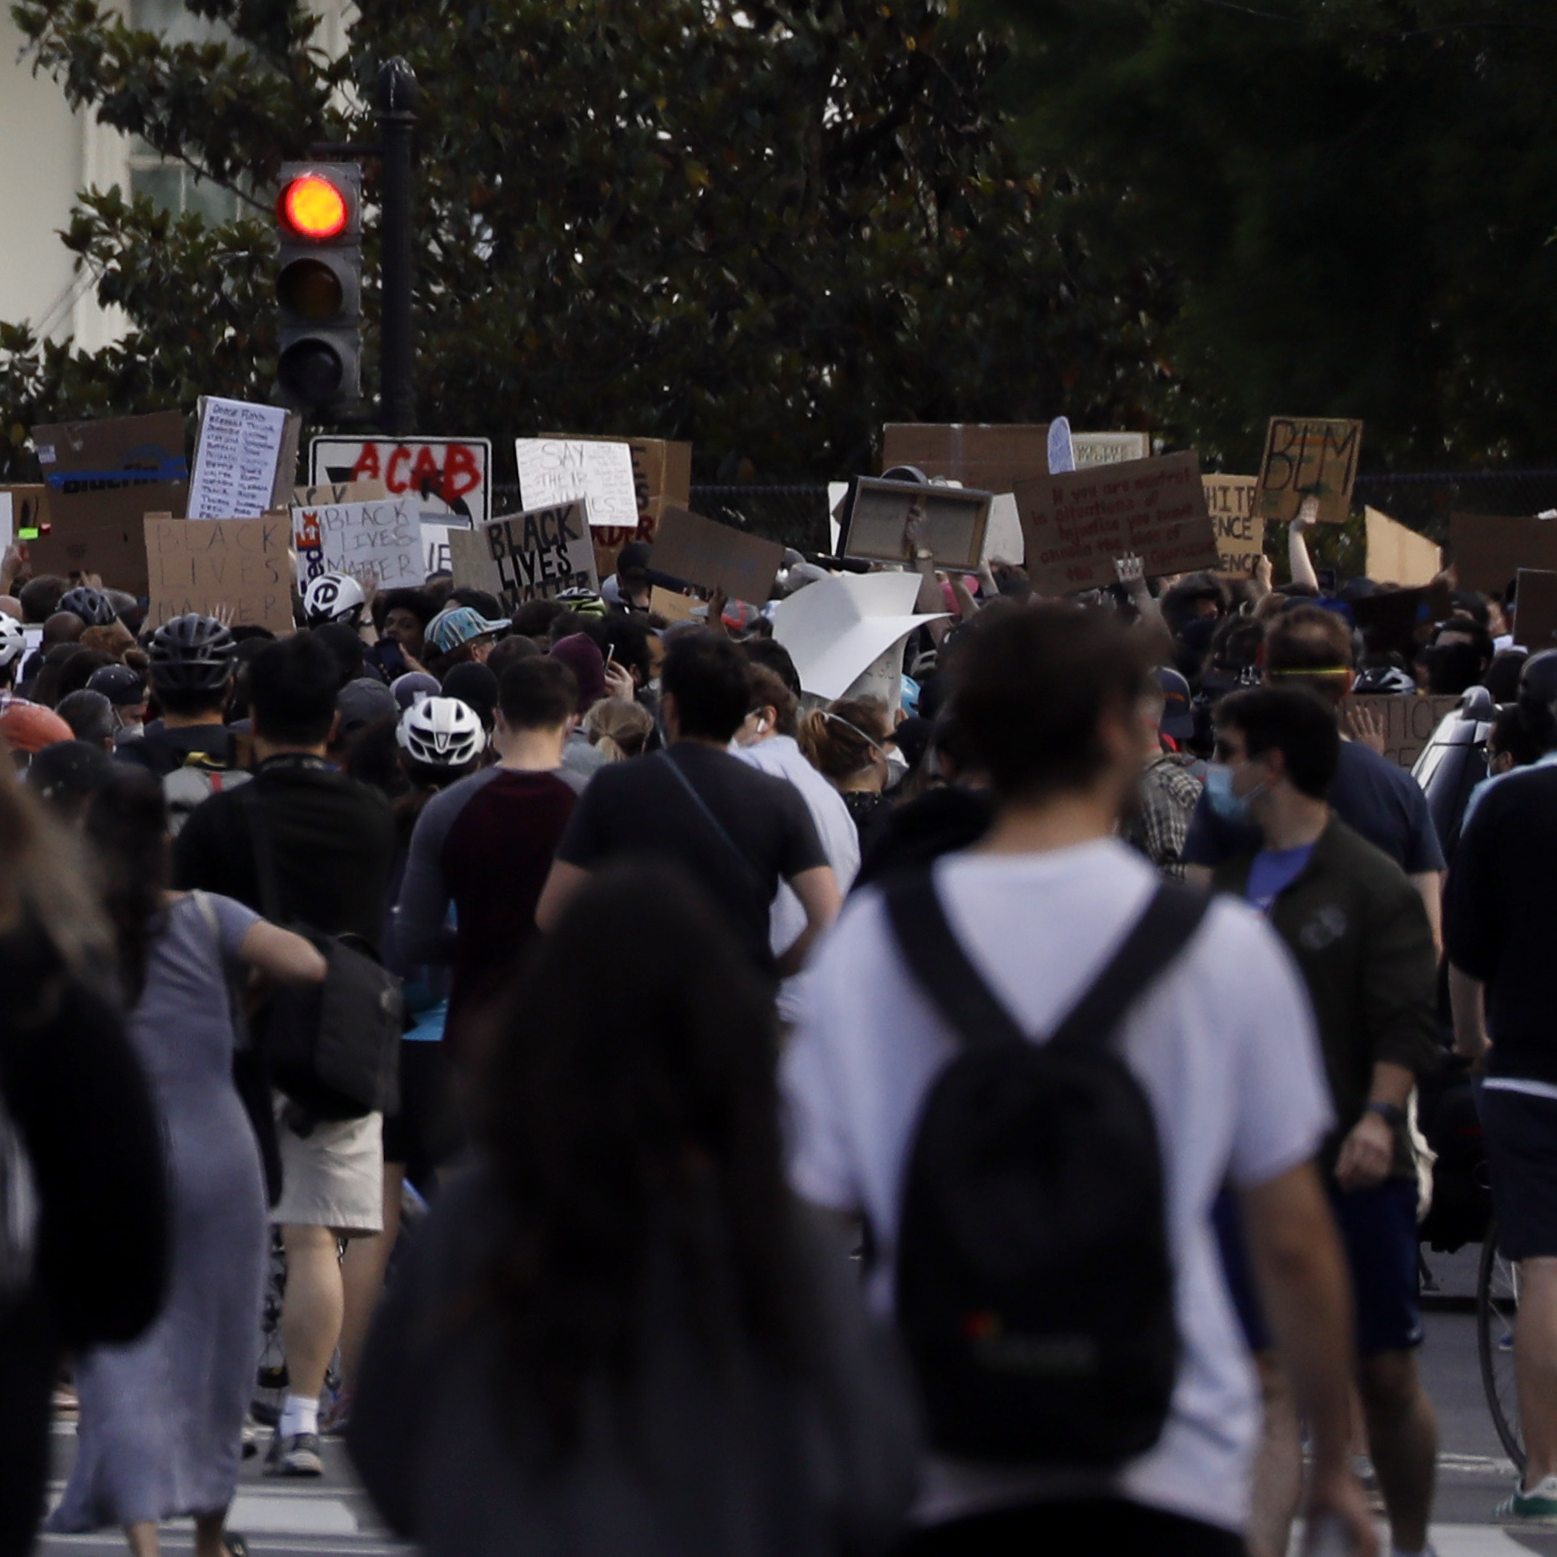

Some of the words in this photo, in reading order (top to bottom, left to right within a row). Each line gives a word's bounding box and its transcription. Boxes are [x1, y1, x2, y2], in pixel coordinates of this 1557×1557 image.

[541, 444, 585, 469] SAY
[1262, 419, 1355, 497] BLM
[350, 442, 482, 503] ACAB
[1204, 485, 1256, 512] HITE
[325, 501, 412, 532] BLACK
[487, 503, 580, 561] BLACK
[1210, 517, 1253, 540] ENCE
[156, 522, 282, 554] BLACK
[340, 525, 412, 554] LIVES
[160, 556, 280, 589] LIVES
[497, 540, 573, 591] LIVES
[157, 594, 278, 625] MAER
